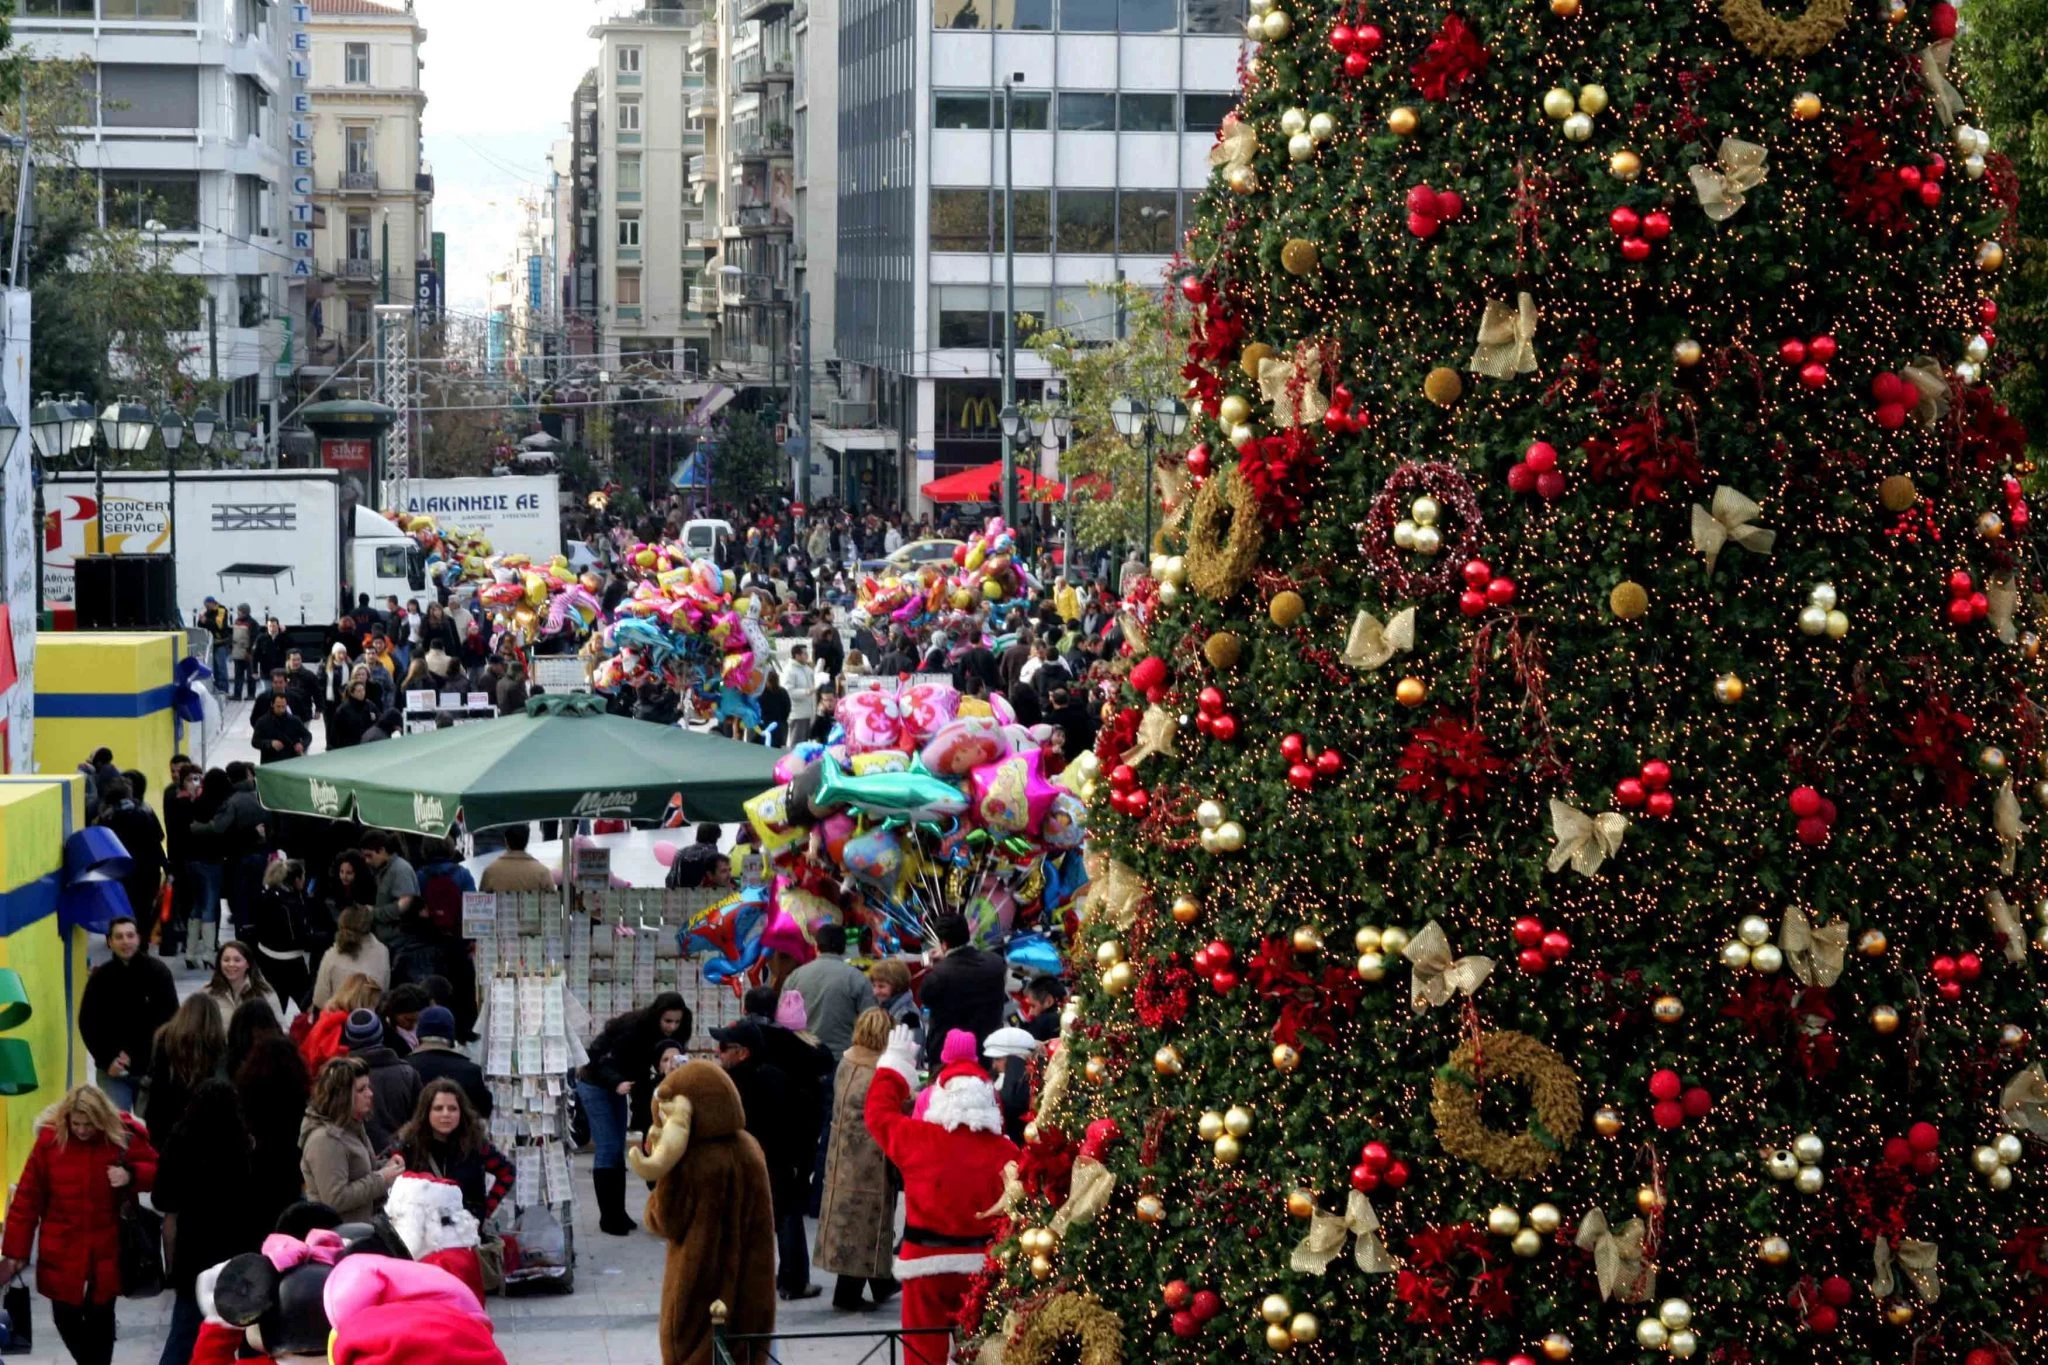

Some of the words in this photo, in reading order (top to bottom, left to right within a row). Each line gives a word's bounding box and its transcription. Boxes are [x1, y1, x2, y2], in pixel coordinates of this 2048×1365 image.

[103, 501, 171, 512] CONCERT
[104, 513, 145, 523] COPA
[104, 523, 166, 534] SERVICE
[571, 790, 638, 817] Mythos
[413, 791, 445, 831] Mythos
